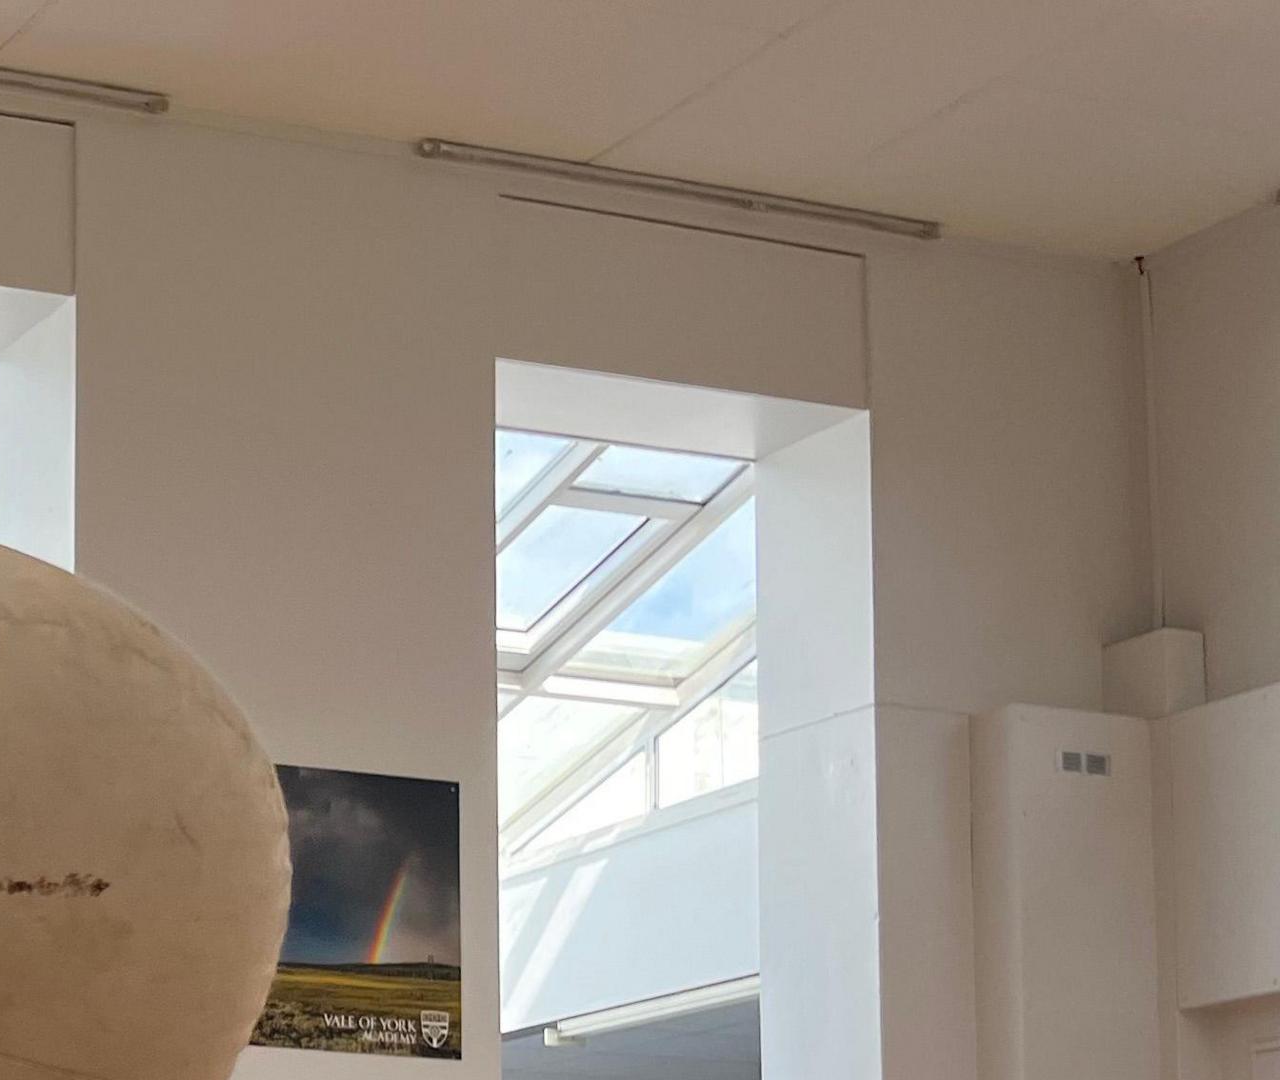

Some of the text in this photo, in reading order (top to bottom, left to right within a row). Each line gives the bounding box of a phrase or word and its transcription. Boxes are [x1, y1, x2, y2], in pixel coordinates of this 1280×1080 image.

[324, 1013, 417, 1033] VALE OF YORK
